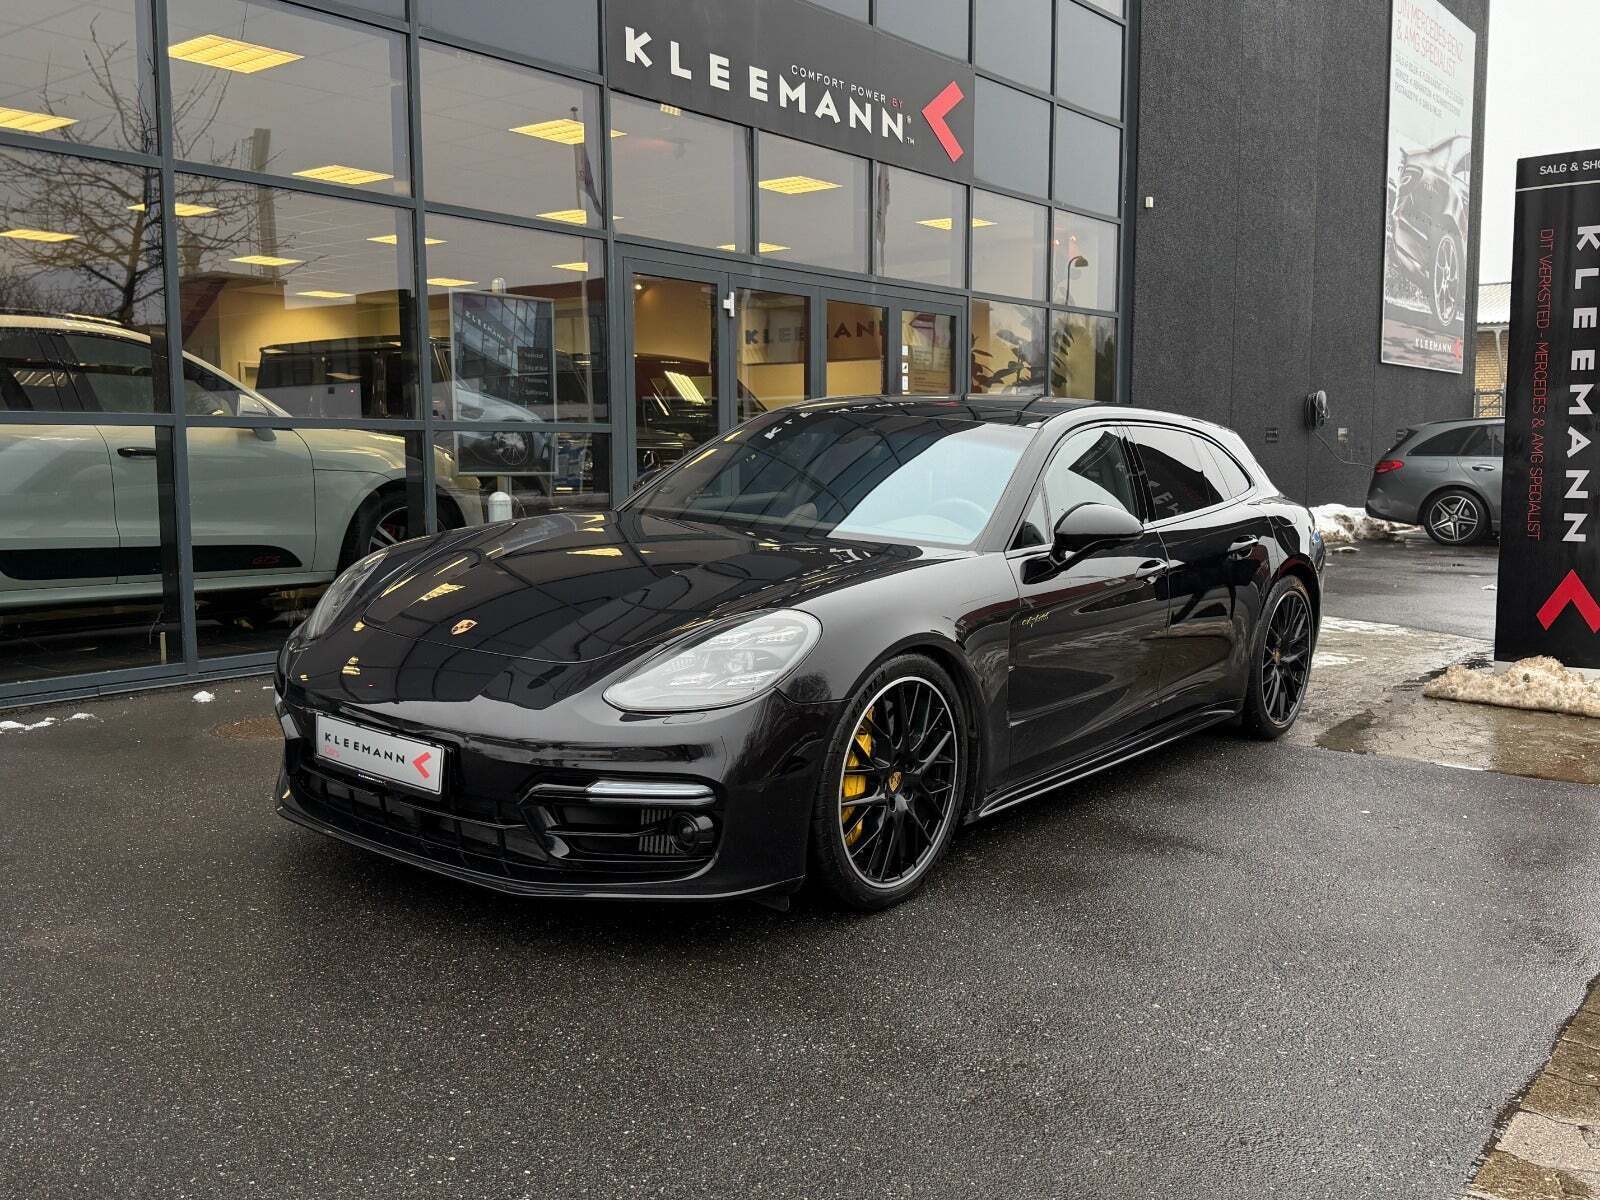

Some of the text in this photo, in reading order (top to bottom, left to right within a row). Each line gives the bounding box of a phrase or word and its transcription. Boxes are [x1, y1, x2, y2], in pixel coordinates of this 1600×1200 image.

[1403, 25, 1421, 53] AMG
[1421, 36, 1456, 79] SPECIALIST
[625, 26, 904, 144] KLEEMANN
[791, 64, 903, 108] COMFORT POWER BY
[1539, 163, 1567, 175] SALG
[1569, 161, 1579, 172] &
[1539, 229, 1554, 251] DIT
[1536, 254, 1552, 329] VÆRKSTED
[1415, 337, 1452, 353] KLEEMANN
[1532, 342, 1548, 414] MERCEDES
[1562, 225, 1600, 542] KLEEMANN
[1531, 418, 1546, 428] &
[1529, 432, 1545, 463] AMG
[1527, 466, 1543, 541] SPECIALIST
[324, 732, 406, 764] KLEEMANN
